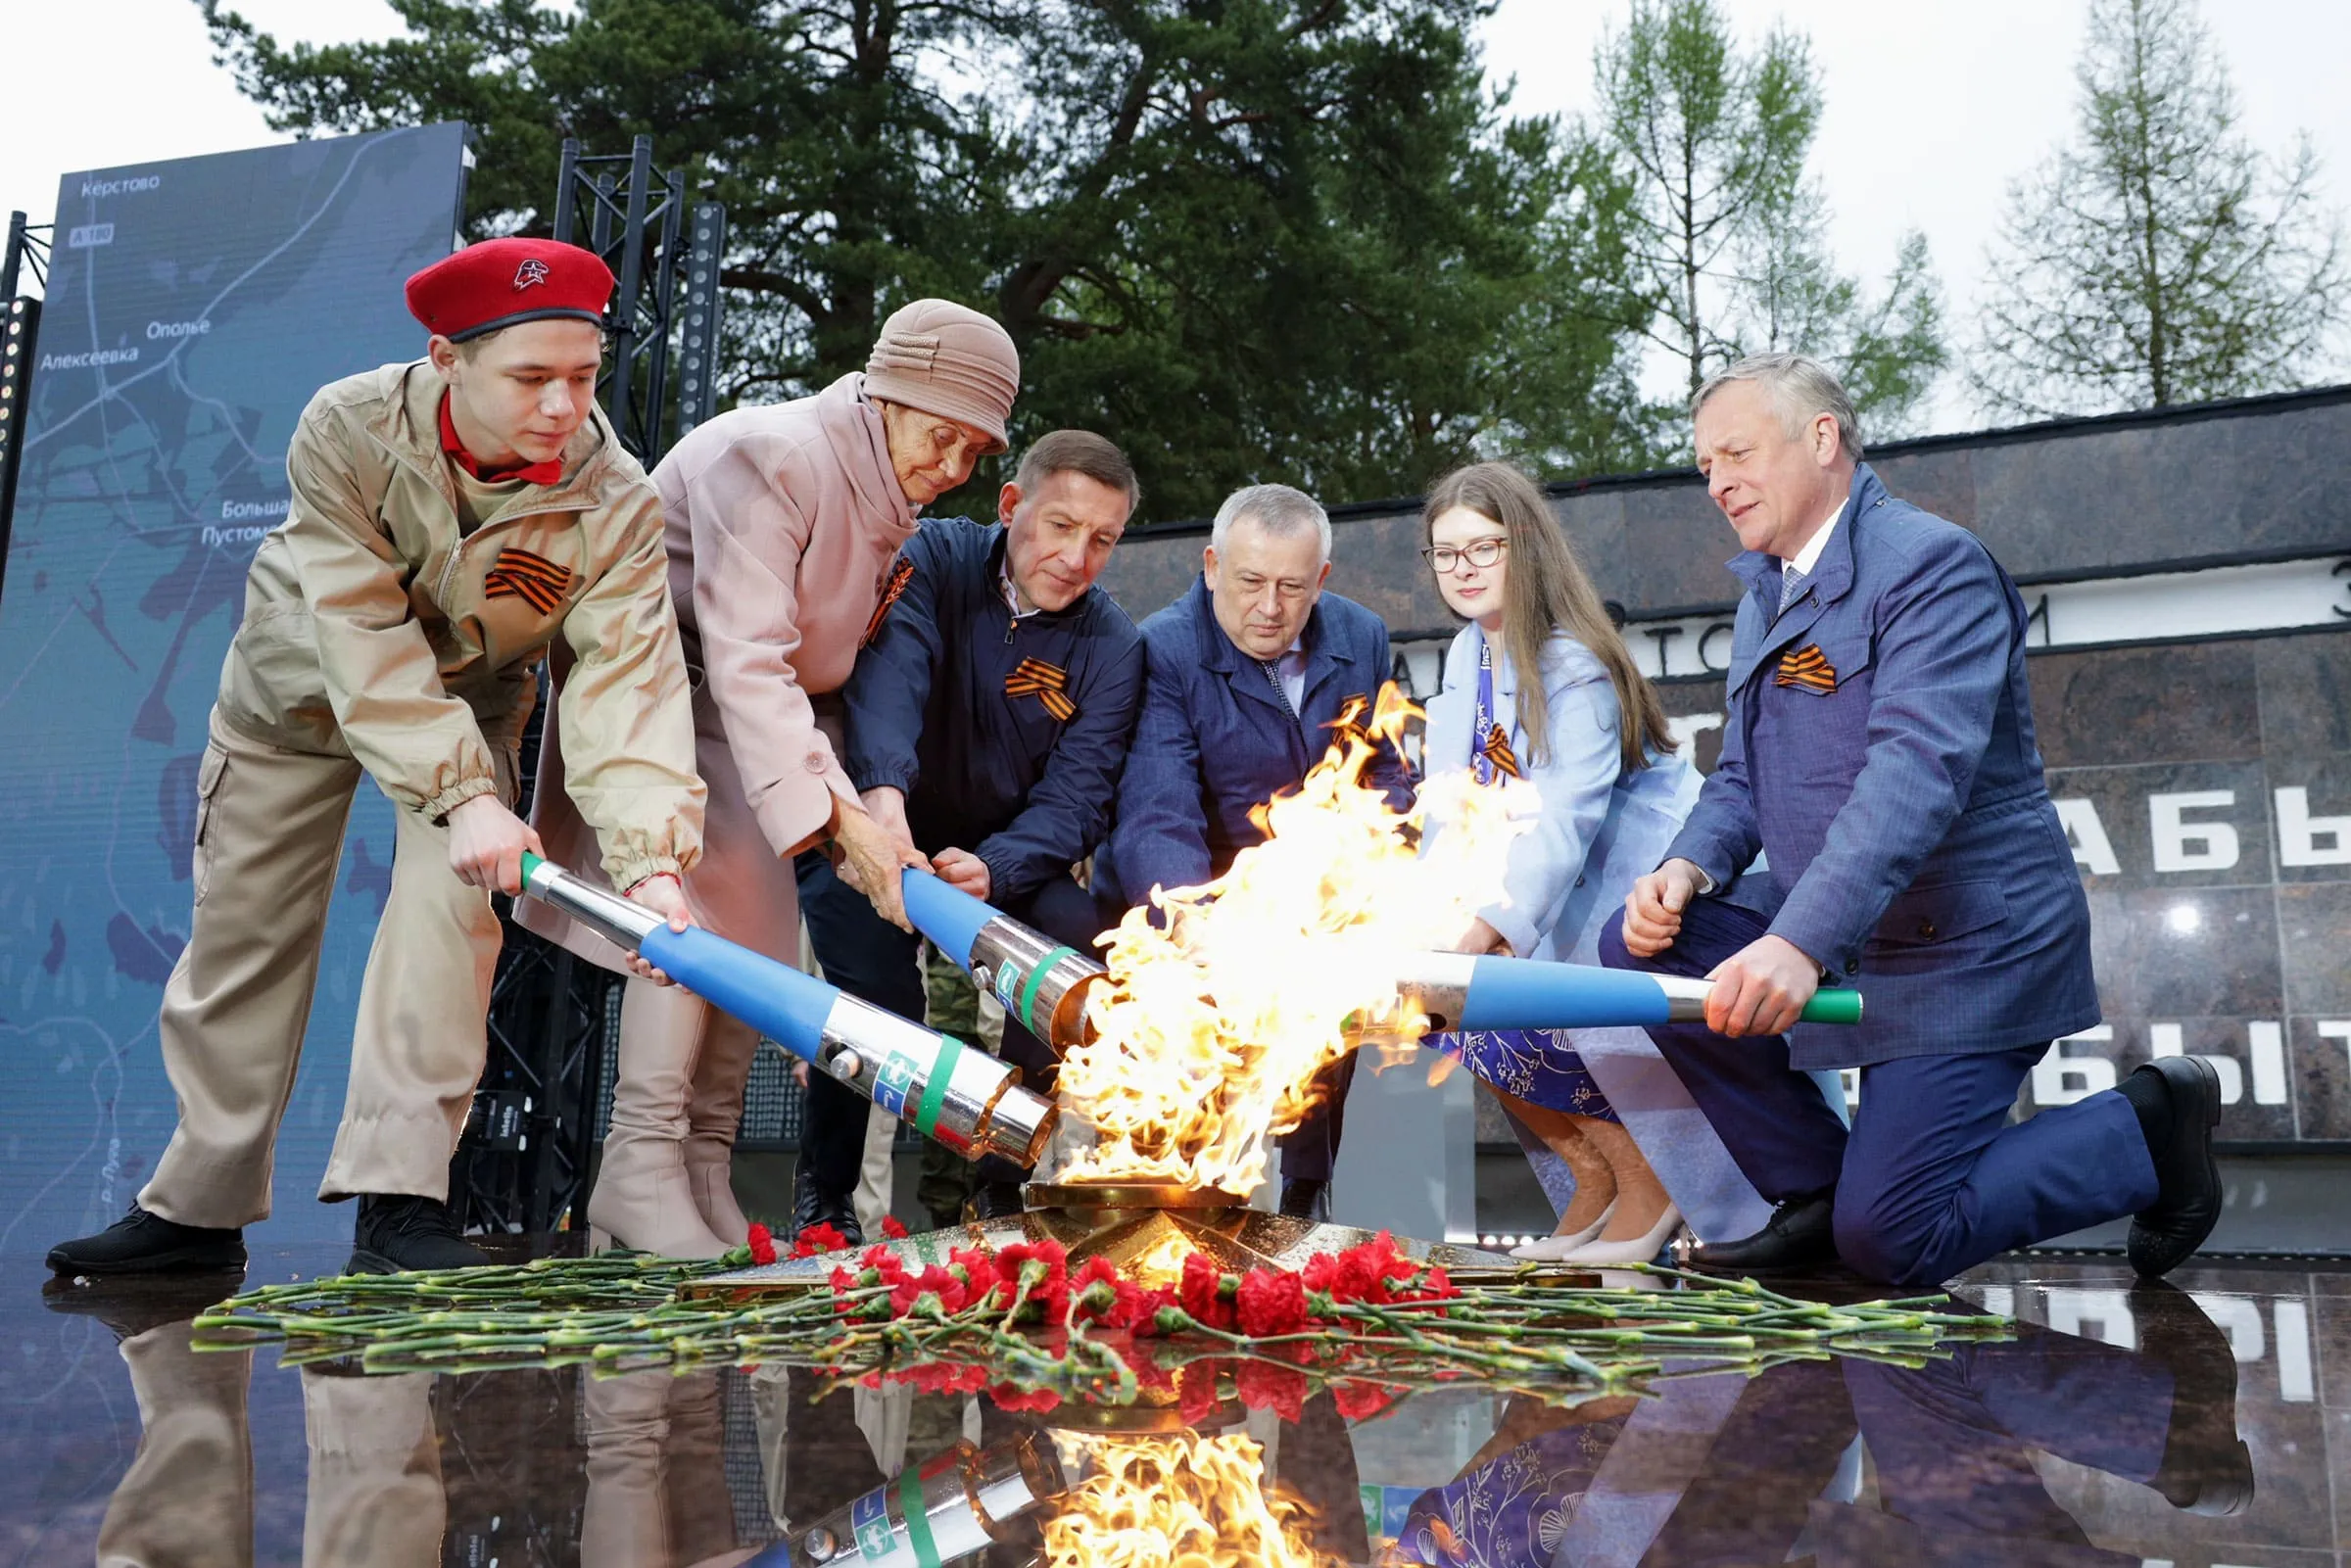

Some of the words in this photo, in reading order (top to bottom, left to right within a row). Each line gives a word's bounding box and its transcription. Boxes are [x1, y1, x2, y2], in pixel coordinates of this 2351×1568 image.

[146, 318, 212, 340] Ополье
[40, 346, 140, 371] Алексеевка
[221, 499, 290, 519] Больша
[201, 525, 277, 547] Пустом
